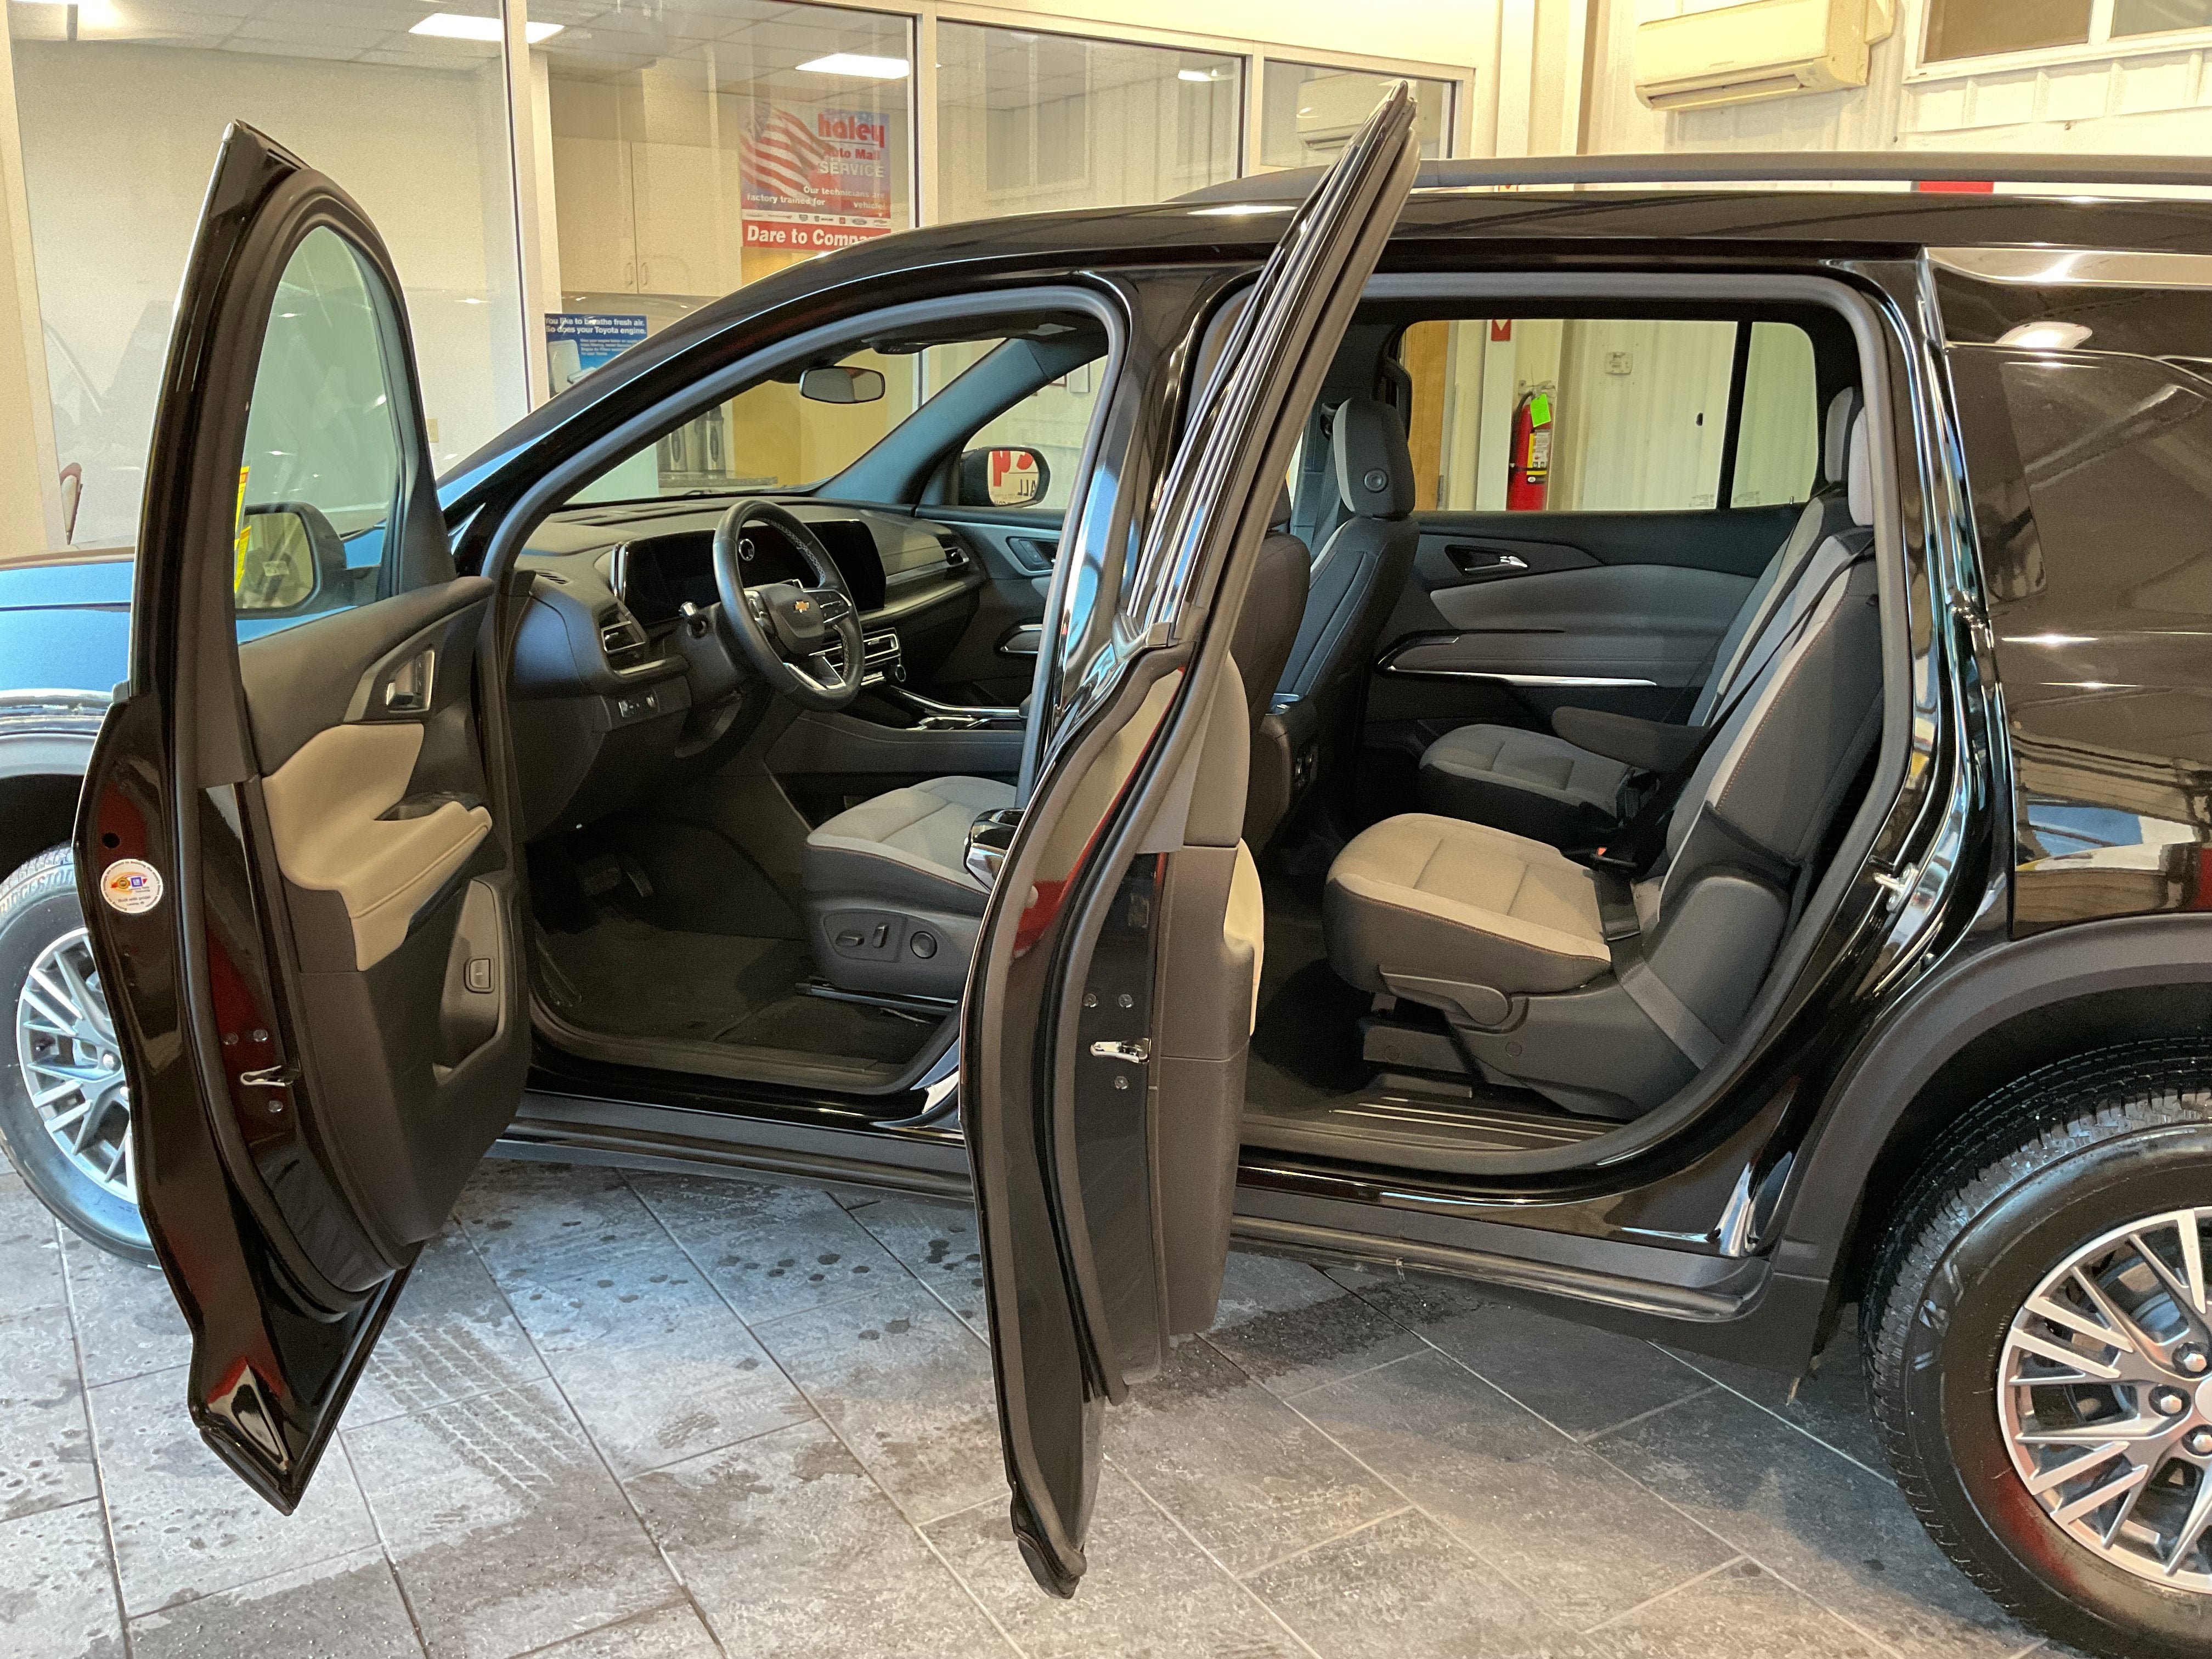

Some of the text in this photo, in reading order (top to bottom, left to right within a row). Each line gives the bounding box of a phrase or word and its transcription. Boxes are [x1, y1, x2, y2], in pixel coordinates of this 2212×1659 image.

[818, 114, 884, 148] haley
[819, 161, 884, 178] SERVICE
[804, 186, 819, 194] Our
[822, 187, 870, 198] technicians
[747, 194, 777, 204] factory
[781, 196, 810, 205] trained
[747, 225, 786, 243] Dare
[791, 228, 807, 244] to
[594, 326, 619, 335] Toyota
